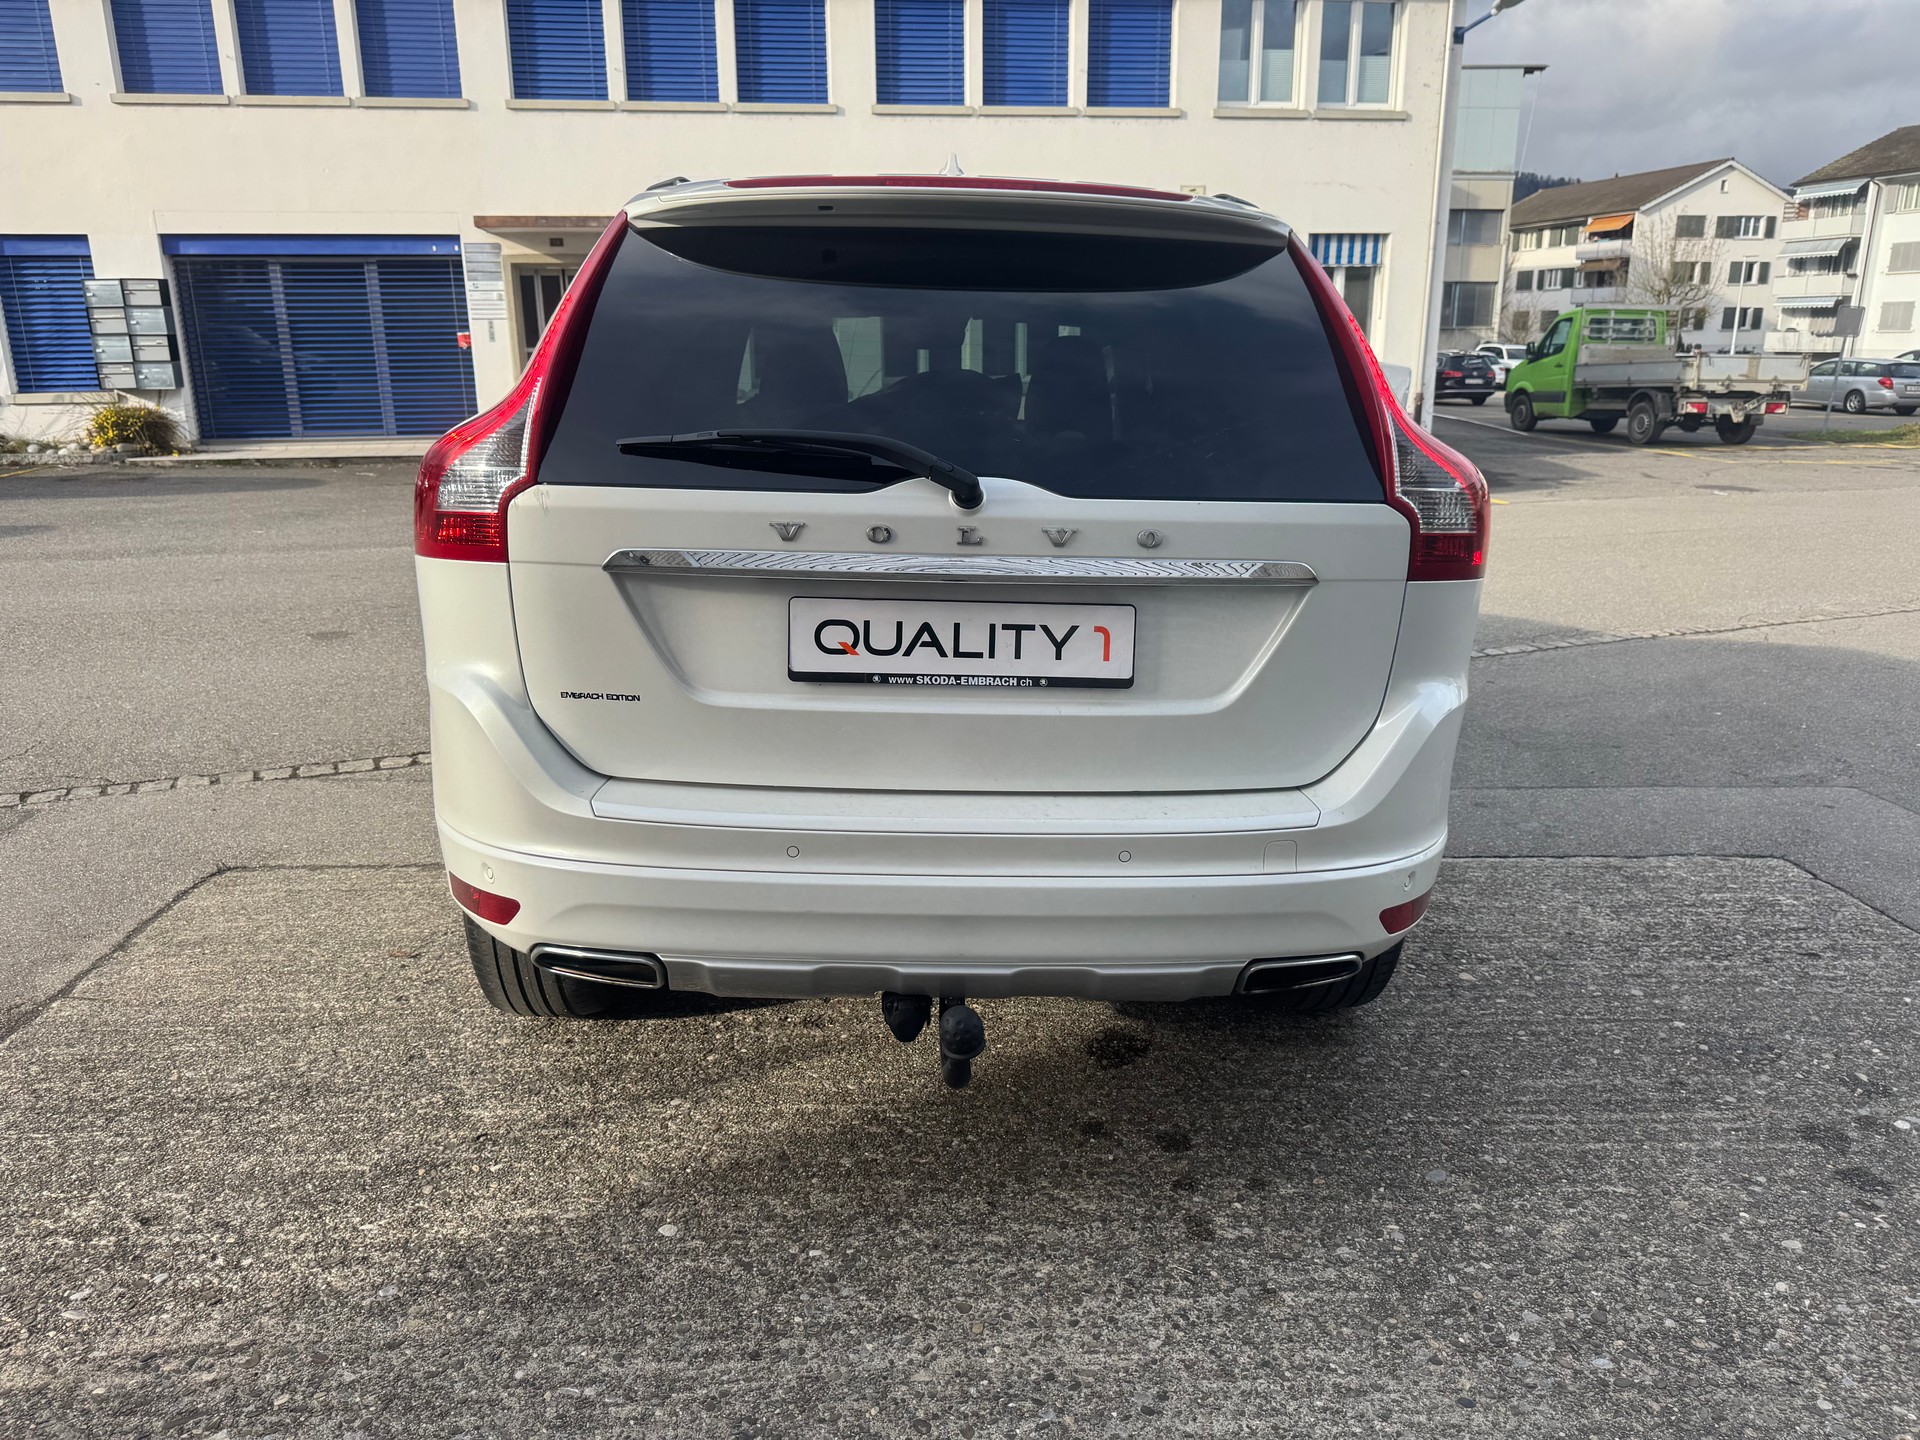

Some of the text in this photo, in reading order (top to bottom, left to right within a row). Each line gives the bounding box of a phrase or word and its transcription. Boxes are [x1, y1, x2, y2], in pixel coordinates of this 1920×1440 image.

[768, 521, 1164, 548] VOLVO
[813, 619, 1111, 662] QUALITY 1
[606, 693, 641, 702] EDITION
